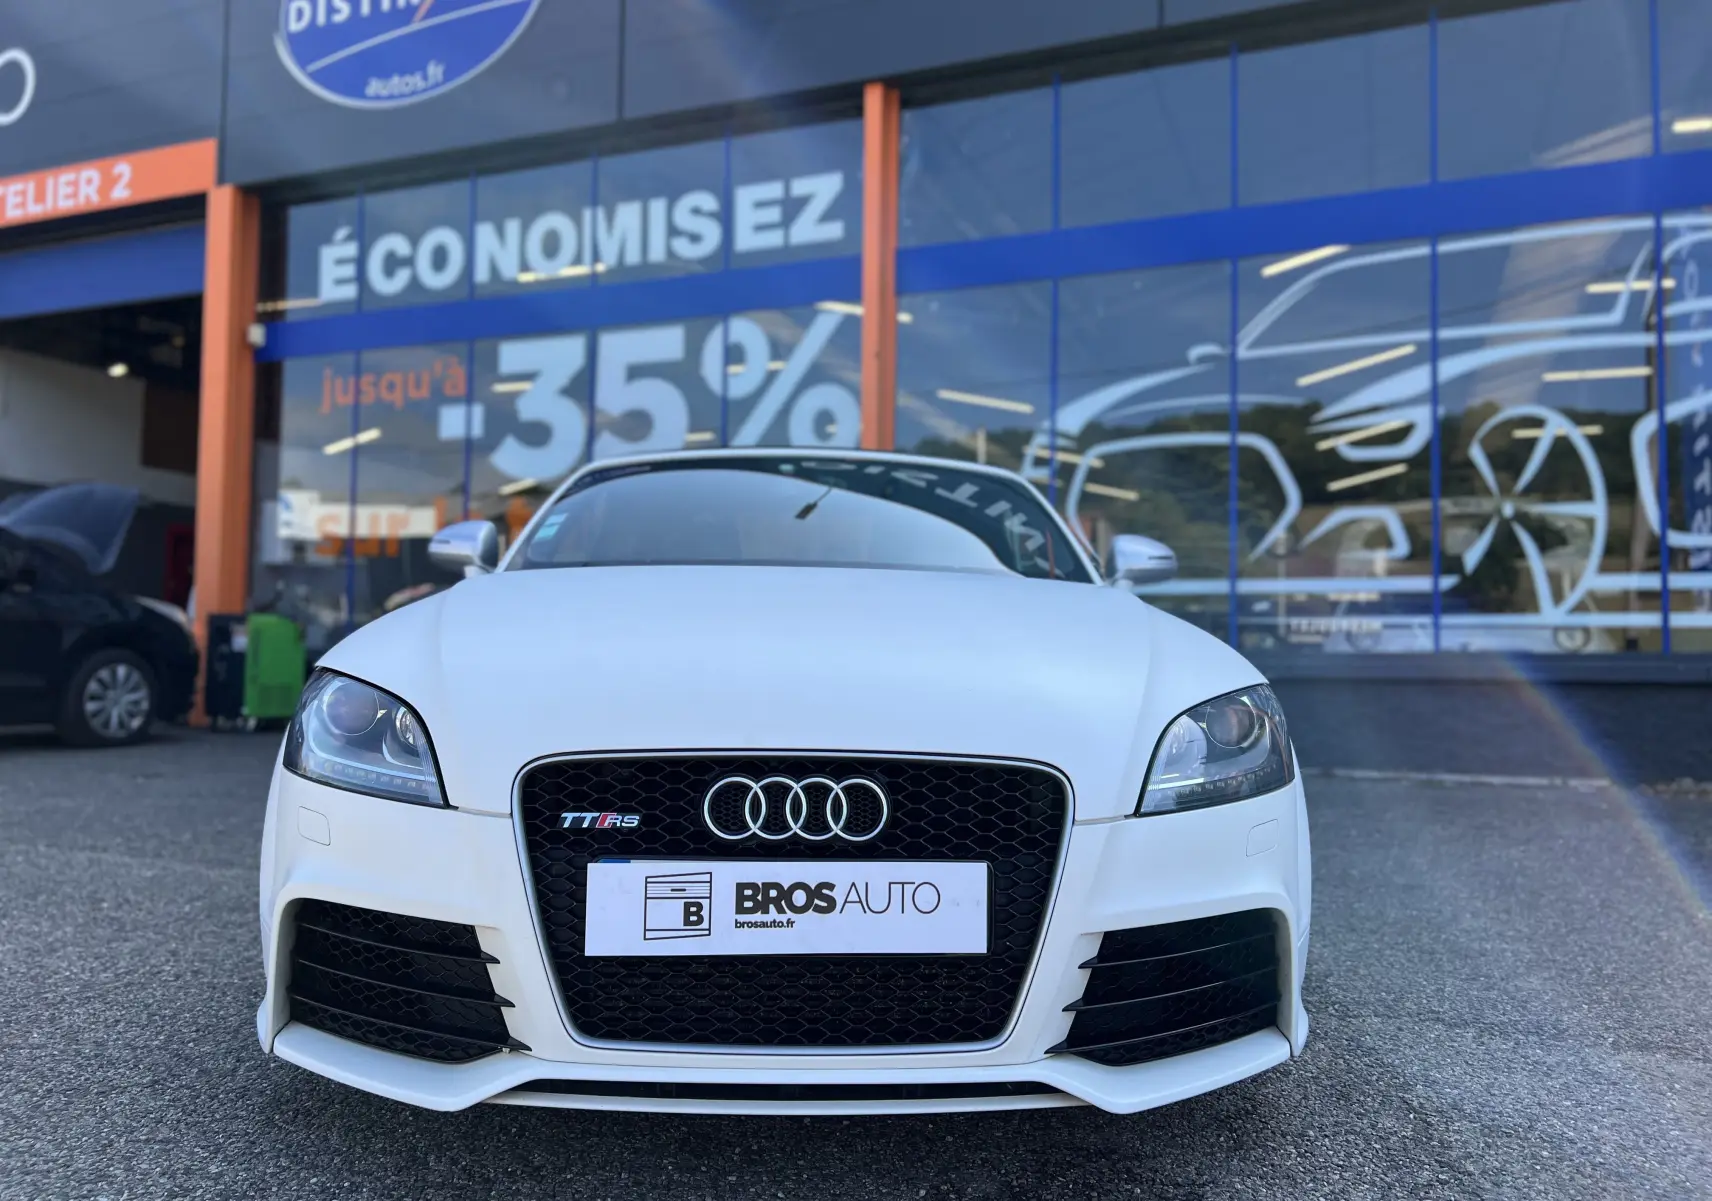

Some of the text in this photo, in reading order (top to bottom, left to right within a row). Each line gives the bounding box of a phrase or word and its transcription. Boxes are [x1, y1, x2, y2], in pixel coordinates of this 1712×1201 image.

[364, 60, 446, 98] autos.fr
[109, 161, 132, 199] 2
[318, 170, 845, 302] ÉCONOMISEZ
[319, 355, 467, 416] jusqu'à
[683, 900, 705, 927] B
[734, 918, 796, 930] brosauto.fr
